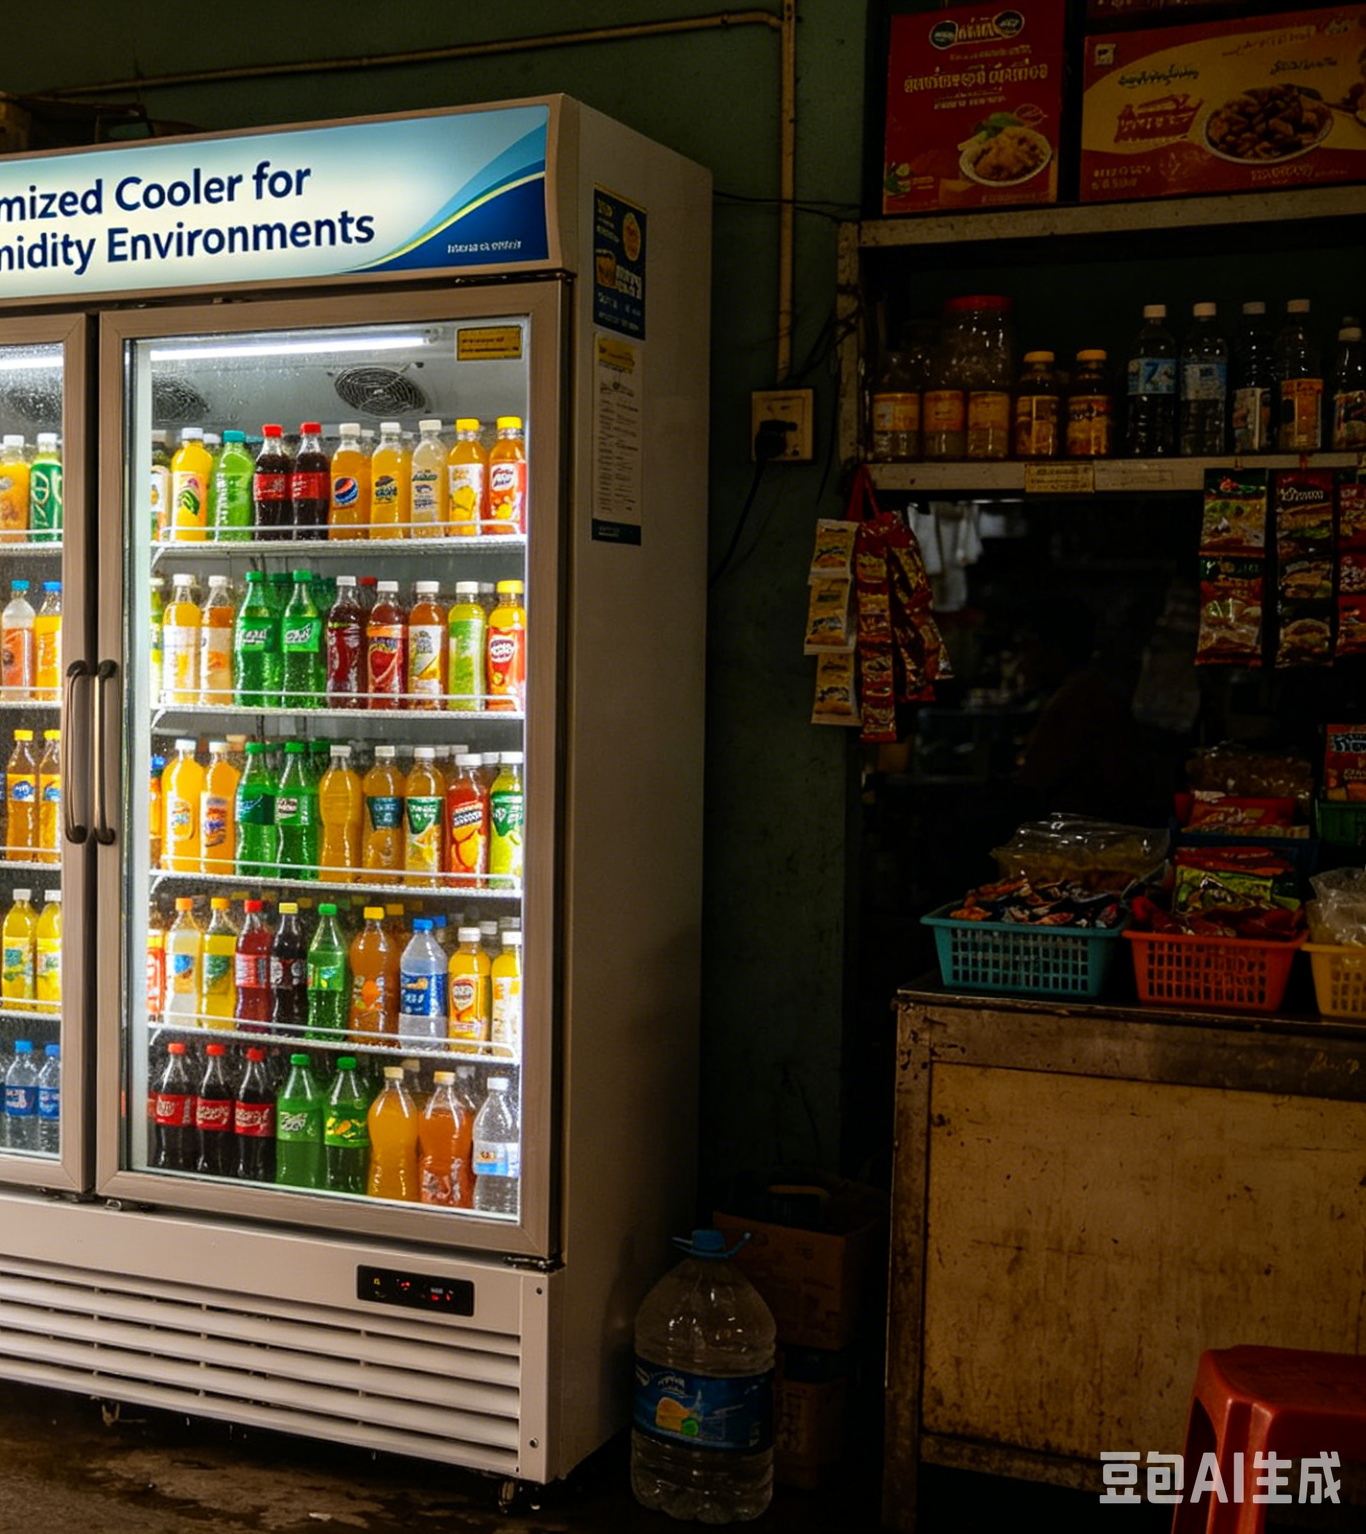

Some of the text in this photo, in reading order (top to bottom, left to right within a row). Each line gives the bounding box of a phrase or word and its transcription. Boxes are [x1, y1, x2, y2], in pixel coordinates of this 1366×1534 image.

[115, 167, 243, 211] Cooler
[252, 160, 312, 200] for
[107, 210, 375, 263] Environments
